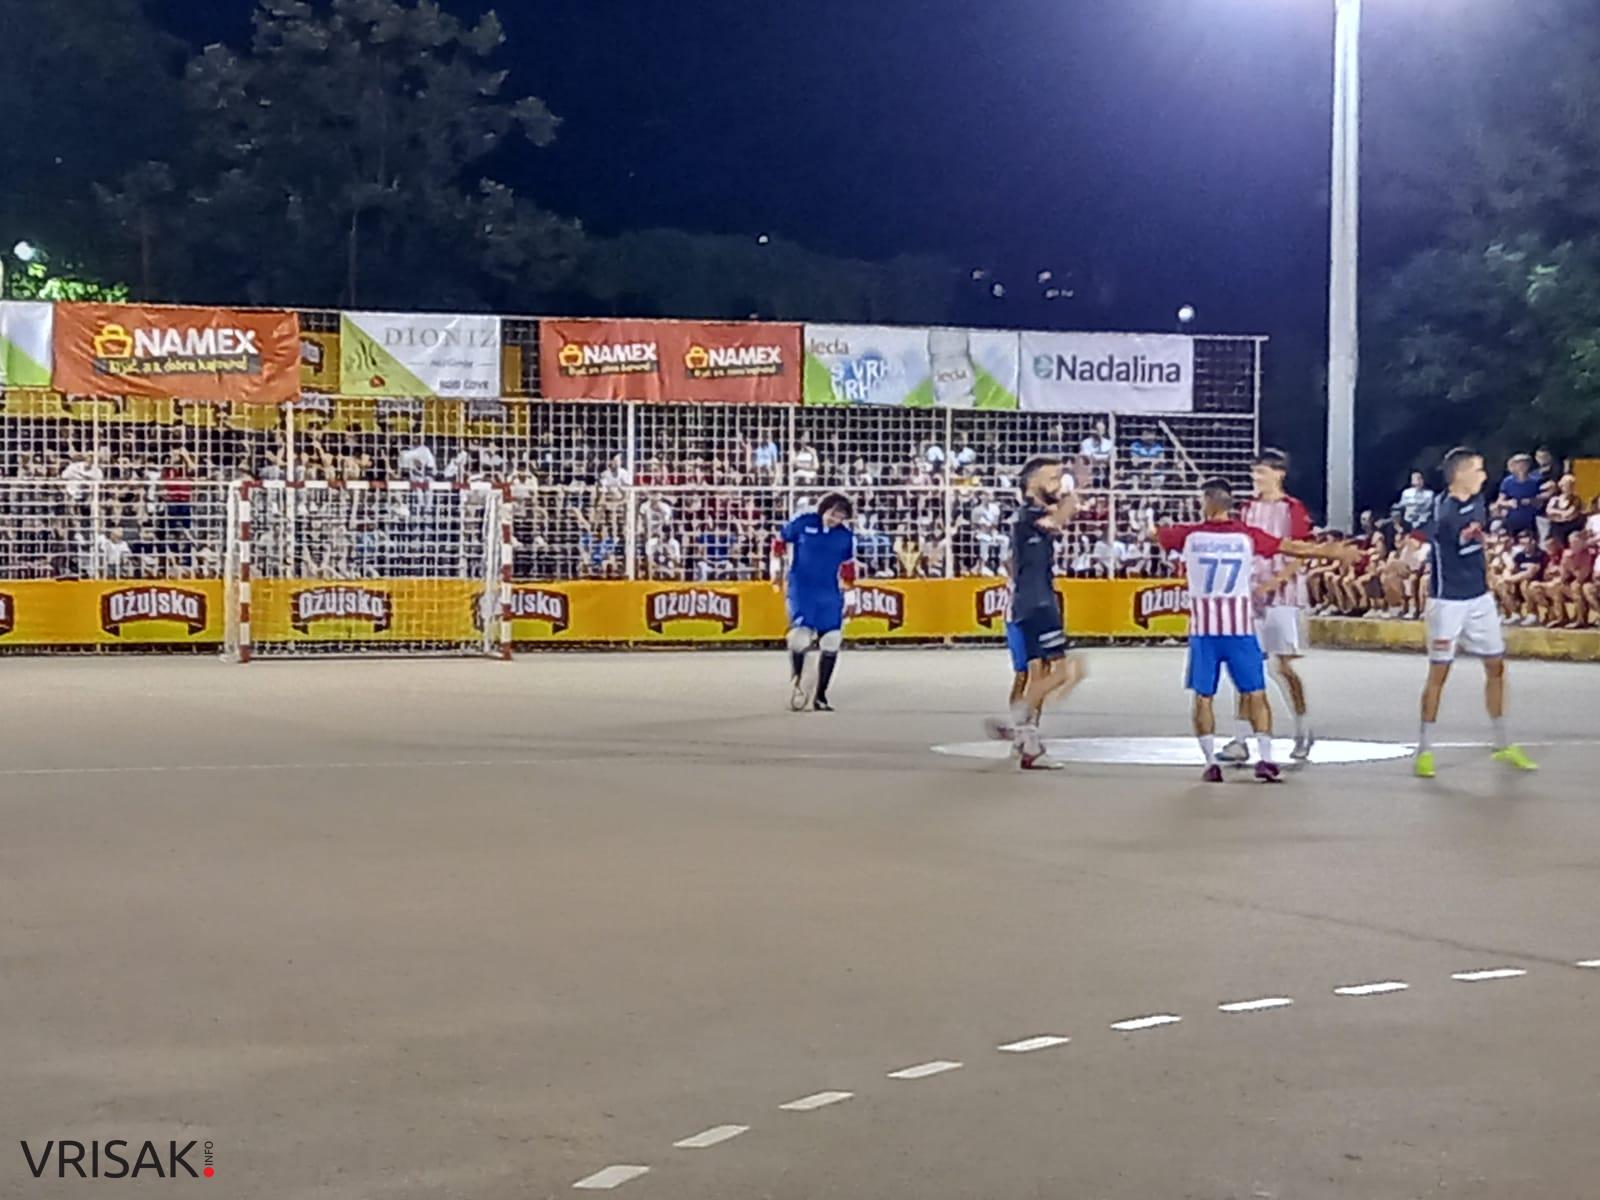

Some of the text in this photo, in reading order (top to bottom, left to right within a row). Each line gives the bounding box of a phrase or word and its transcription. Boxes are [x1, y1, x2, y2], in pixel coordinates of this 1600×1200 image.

[134, 327, 257, 356] NAMEX
[385, 327, 496, 347] DIONIZ
[583, 343, 657, 364] NAMEX
[709, 346, 781, 367] NAMEX
[1056, 354, 1181, 383] Nadalina
[1199, 557, 1242, 594] 77
[109, 588, 199, 621] Ožujsko
[299, 587, 385, 619] Ožujsko
[654, 589, 732, 620] Ožujsko
